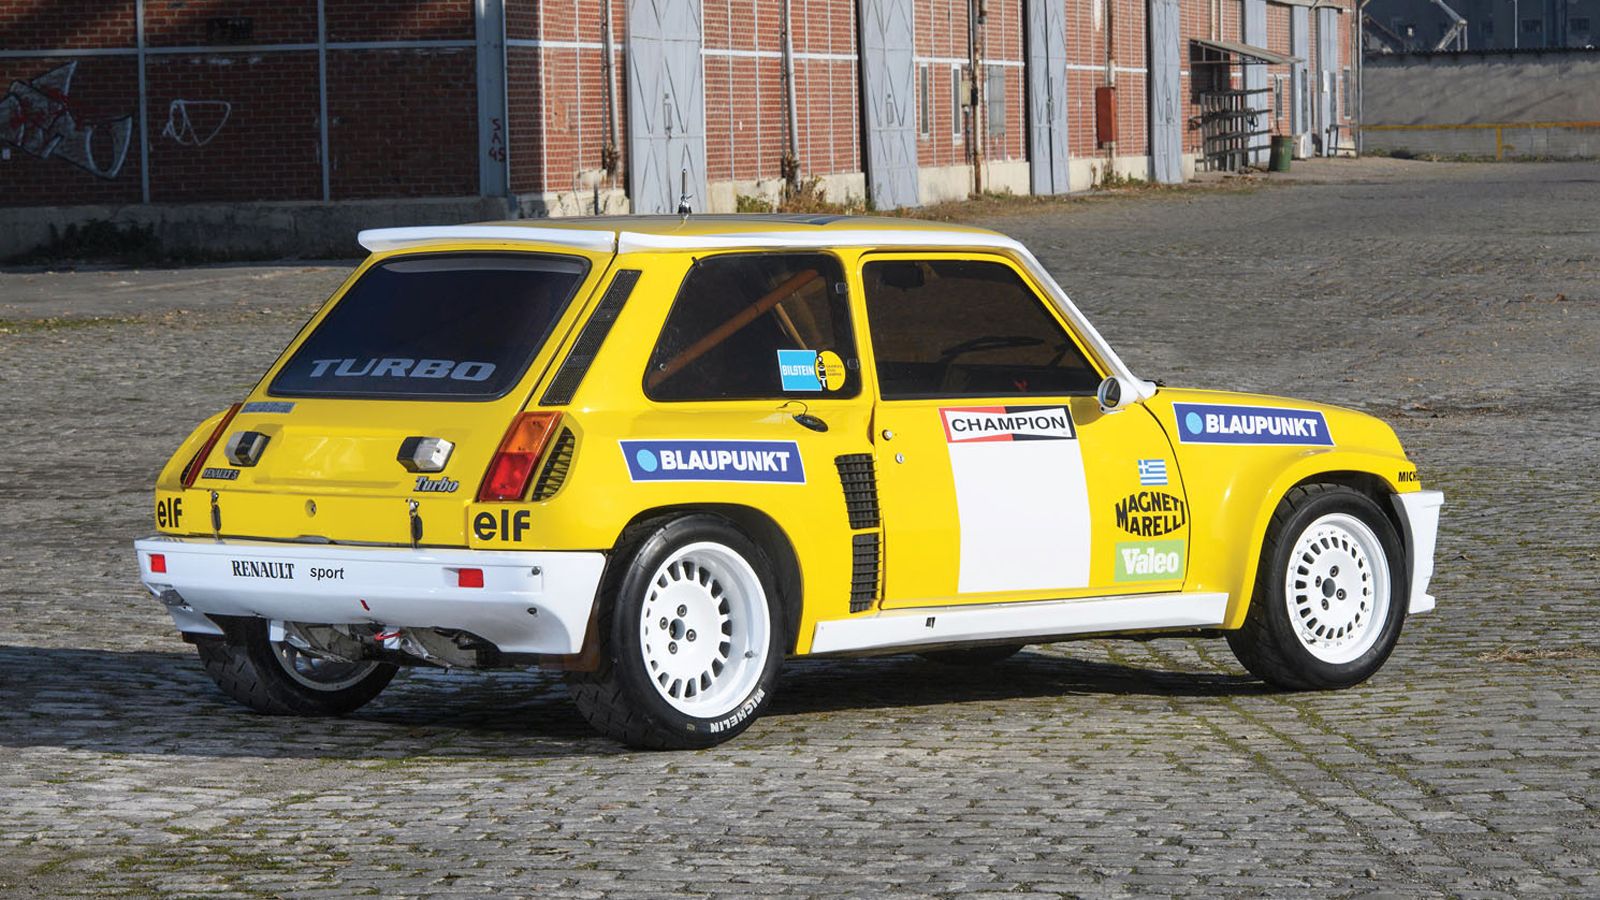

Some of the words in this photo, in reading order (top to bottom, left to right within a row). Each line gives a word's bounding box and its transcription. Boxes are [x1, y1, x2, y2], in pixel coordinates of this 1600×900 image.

[309, 357, 497, 382] TURBO
[781, 364, 816, 377] BILSTEIN
[951, 416, 1066, 432] CHAMPION
[1205, 413, 1318, 438] BLAUPUNKT
[659, 449, 790, 472] BLAUPUNKT
[413, 475, 460, 493] Turbo
[1397, 471, 1420, 482] MICH
[157, 497, 183, 528] elf
[1115, 491, 1186, 519] MAGNETI
[473, 509, 531, 541] elf
[1115, 510, 1186, 537] MARELLI
[231, 560, 294, 580] RENAULT
[309, 566, 345, 581] sport
[1121, 547, 1179, 575] Valeo
[709, 688, 766, 734] MICHELIN
